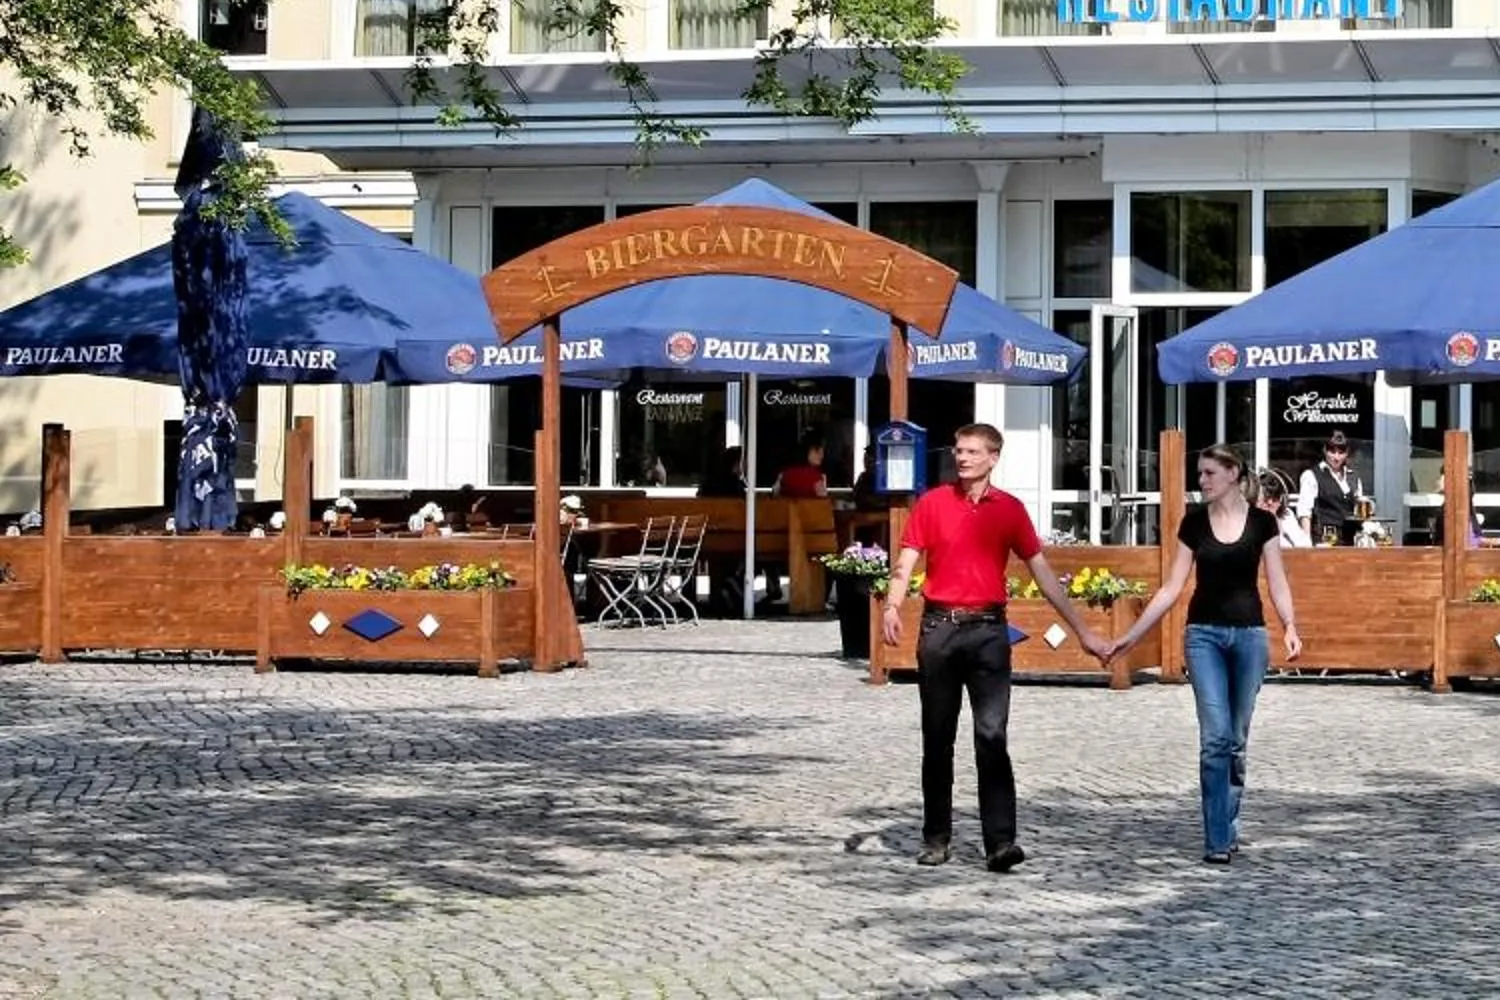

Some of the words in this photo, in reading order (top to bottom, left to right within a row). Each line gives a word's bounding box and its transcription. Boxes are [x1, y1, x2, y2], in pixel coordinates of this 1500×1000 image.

[585, 225, 847, 280] BIERGARTEN
[6, 343, 124, 365] PAULANER
[247, 347, 337, 370] ULANER
[481, 338, 604, 367] PAULNER
[702, 337, 831, 364] PAULANER
[915, 341, 978, 365] PAULANER
[1015, 346, 1069, 373] PAULANER
[1245, 338, 1379, 368] PAULANER
